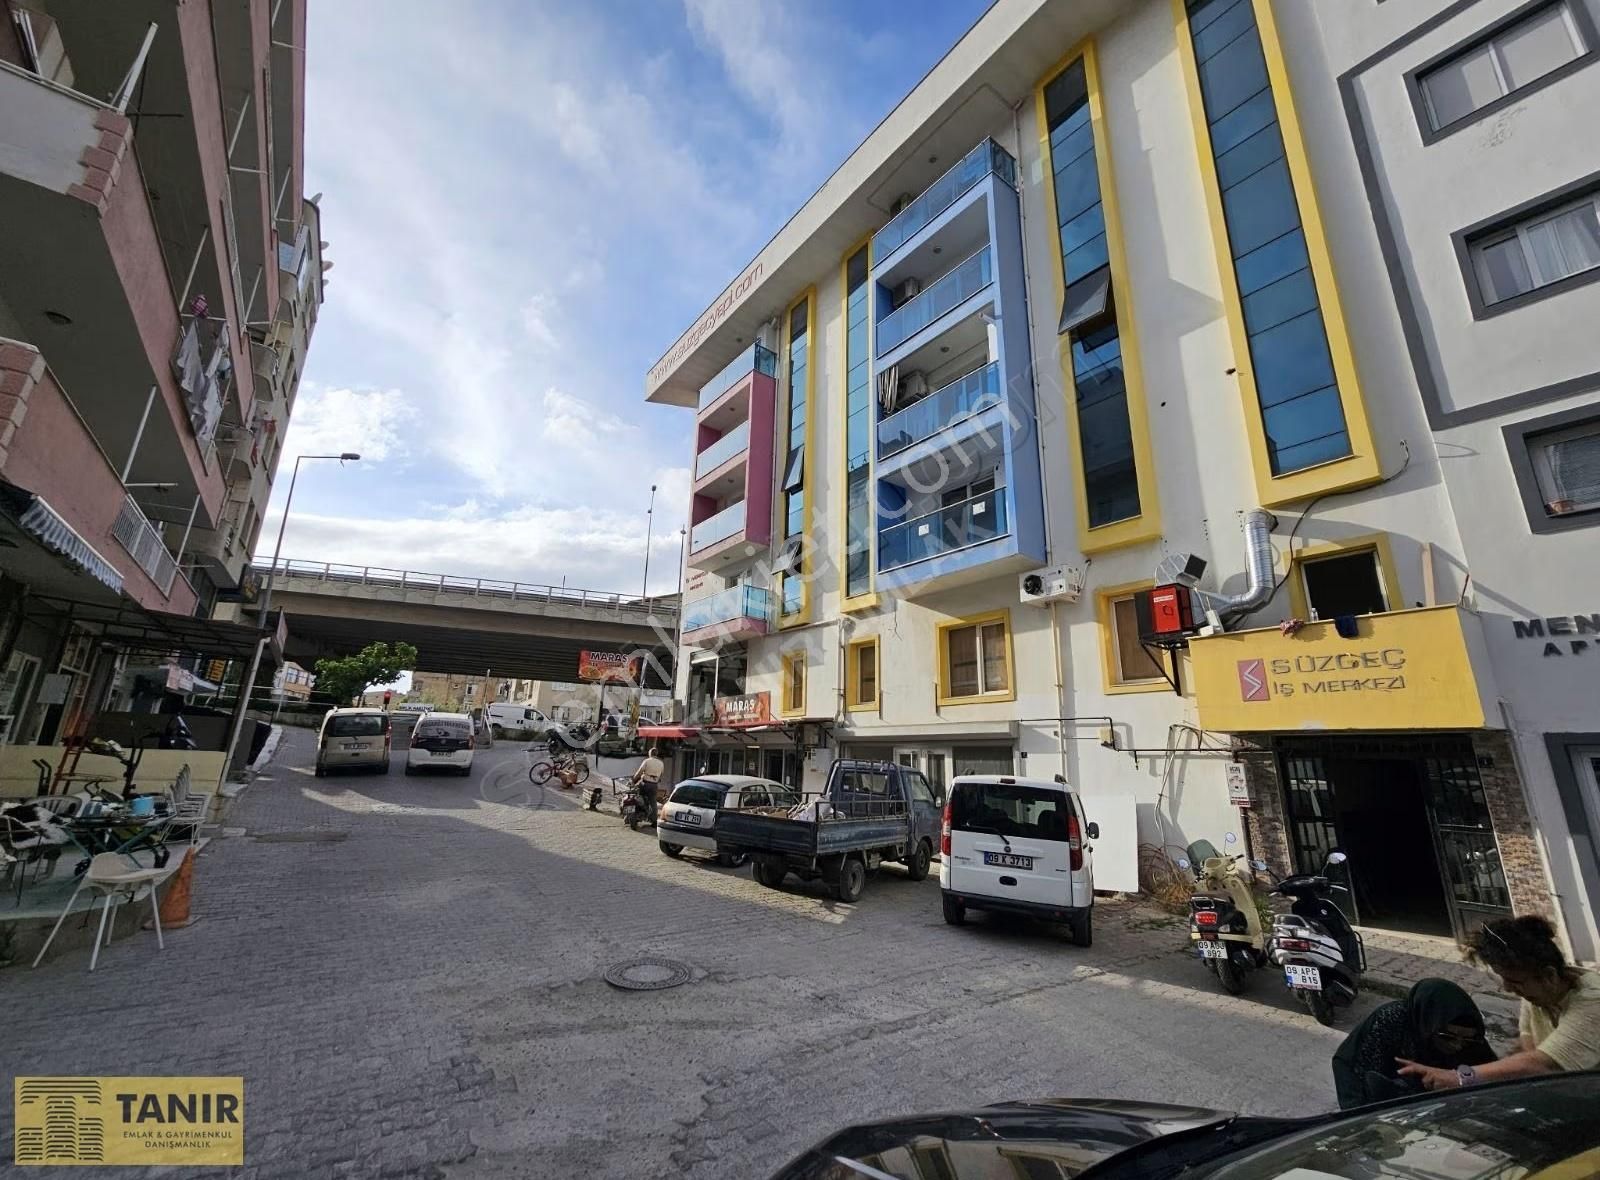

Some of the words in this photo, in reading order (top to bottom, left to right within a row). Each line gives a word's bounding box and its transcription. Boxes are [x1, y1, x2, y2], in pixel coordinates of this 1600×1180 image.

[1544, 639, 1600, 657] AP
[1271, 649, 1406, 675] SÜZGEÇ
[988, 854, 998, 863] 09
[1001, 855, 1007, 864] K
[1010, 856, 1031, 867] 3713
[1198, 941, 1208, 949] 09
[1286, 966, 1298, 974] 09
[1301, 967, 1317, 976] APC
